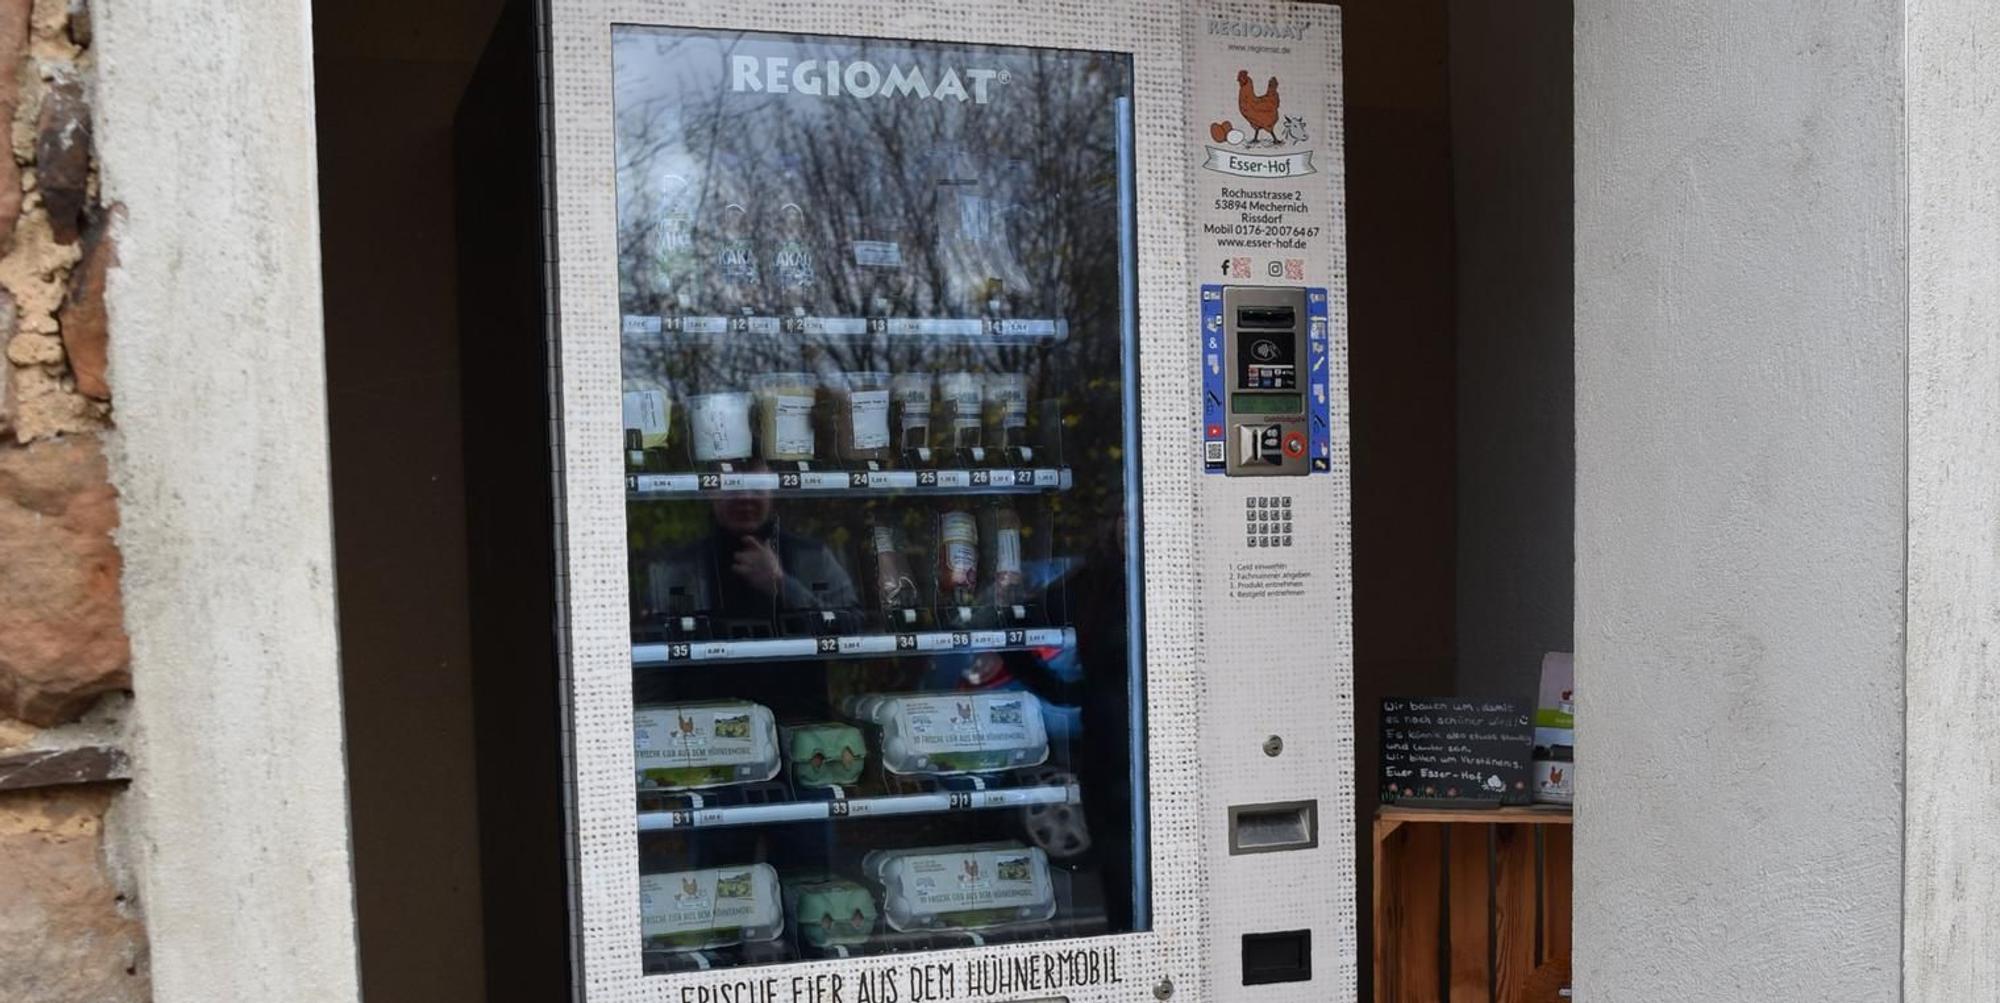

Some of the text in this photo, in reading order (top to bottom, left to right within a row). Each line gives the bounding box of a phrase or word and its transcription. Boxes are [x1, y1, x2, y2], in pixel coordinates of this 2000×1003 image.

[1229, 156, 1290, 175] Esser-Hof
[1221, 187, 1302, 201] Rochusstrasse 2
[1215, 199, 1308, 213] 53894 Mechernich
[1241, 213, 1283, 223] Rissdorf
[1204, 223, 1233, 234] Mobil
[1217, 238, 1307, 249] www.esser-hof.de
[665, 317, 680, 330] 11
[732, 318, 746, 331] 12
[871, 319, 886, 331] 13
[703, 475, 718, 487] 22
[783, 474, 798, 486] 23
[853, 473, 867, 485] 24
[920, 472, 935, 484] 25
[973, 471, 987, 483] 26
[1018, 471, 1032, 482] 27
[900, 636, 915, 648] 34
[953, 634, 968, 645] 36
[1009, 631, 1023, 642] 37
[673, 644, 688, 657] 35
[821, 639, 836, 651] 32
[1384, 701, 1404, 711] Wir
[1409, 700, 1448, 711] bauen
[1386, 766, 1412, 777] Euer
[833, 802, 848, 814] 33
[673, 812, 690, 824] 31
[857, 967, 898, 1003] AUS
[910, 962, 955, 1002] DEM
[967, 946, 1123, 997] HÜHNERMOBIL
